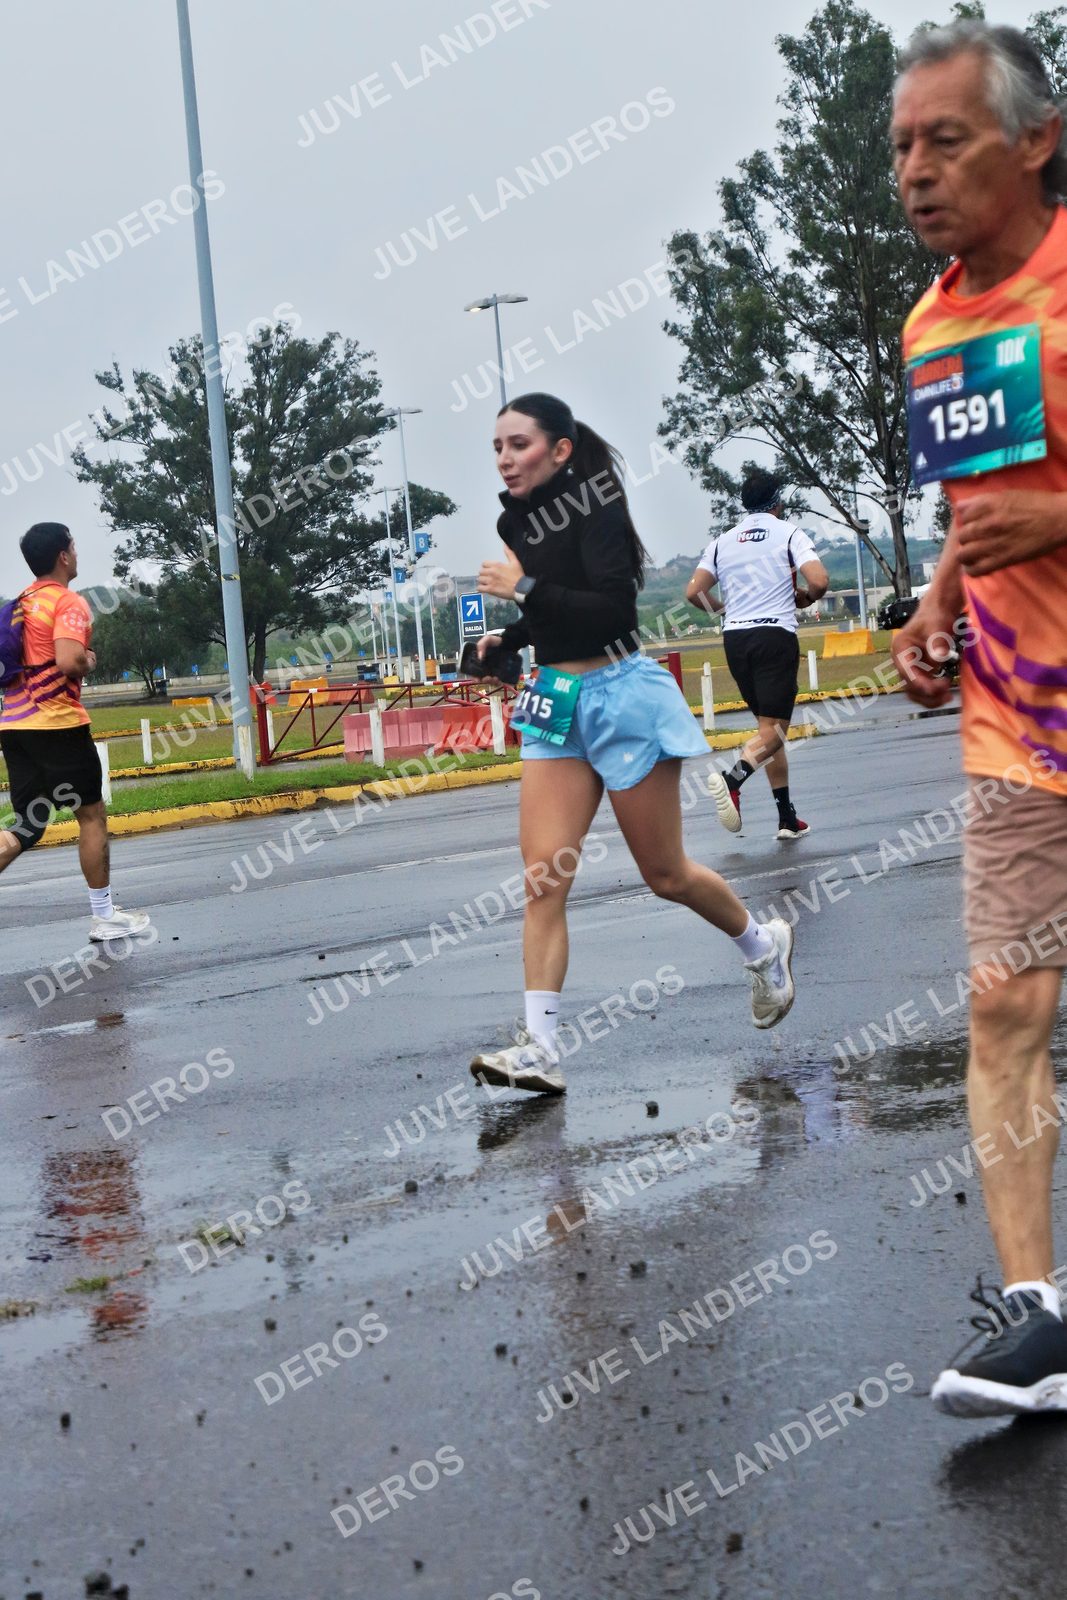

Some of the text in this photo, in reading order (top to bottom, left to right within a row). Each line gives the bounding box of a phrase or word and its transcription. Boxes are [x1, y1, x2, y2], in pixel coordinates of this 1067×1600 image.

[995, 336, 1027, 367] 10K
[928, 389, 1006, 443] 1591
[418, 537, 425, 549] 8
[737, 528, 769, 543] Nutri
[553, 677, 573, 693] 10K
